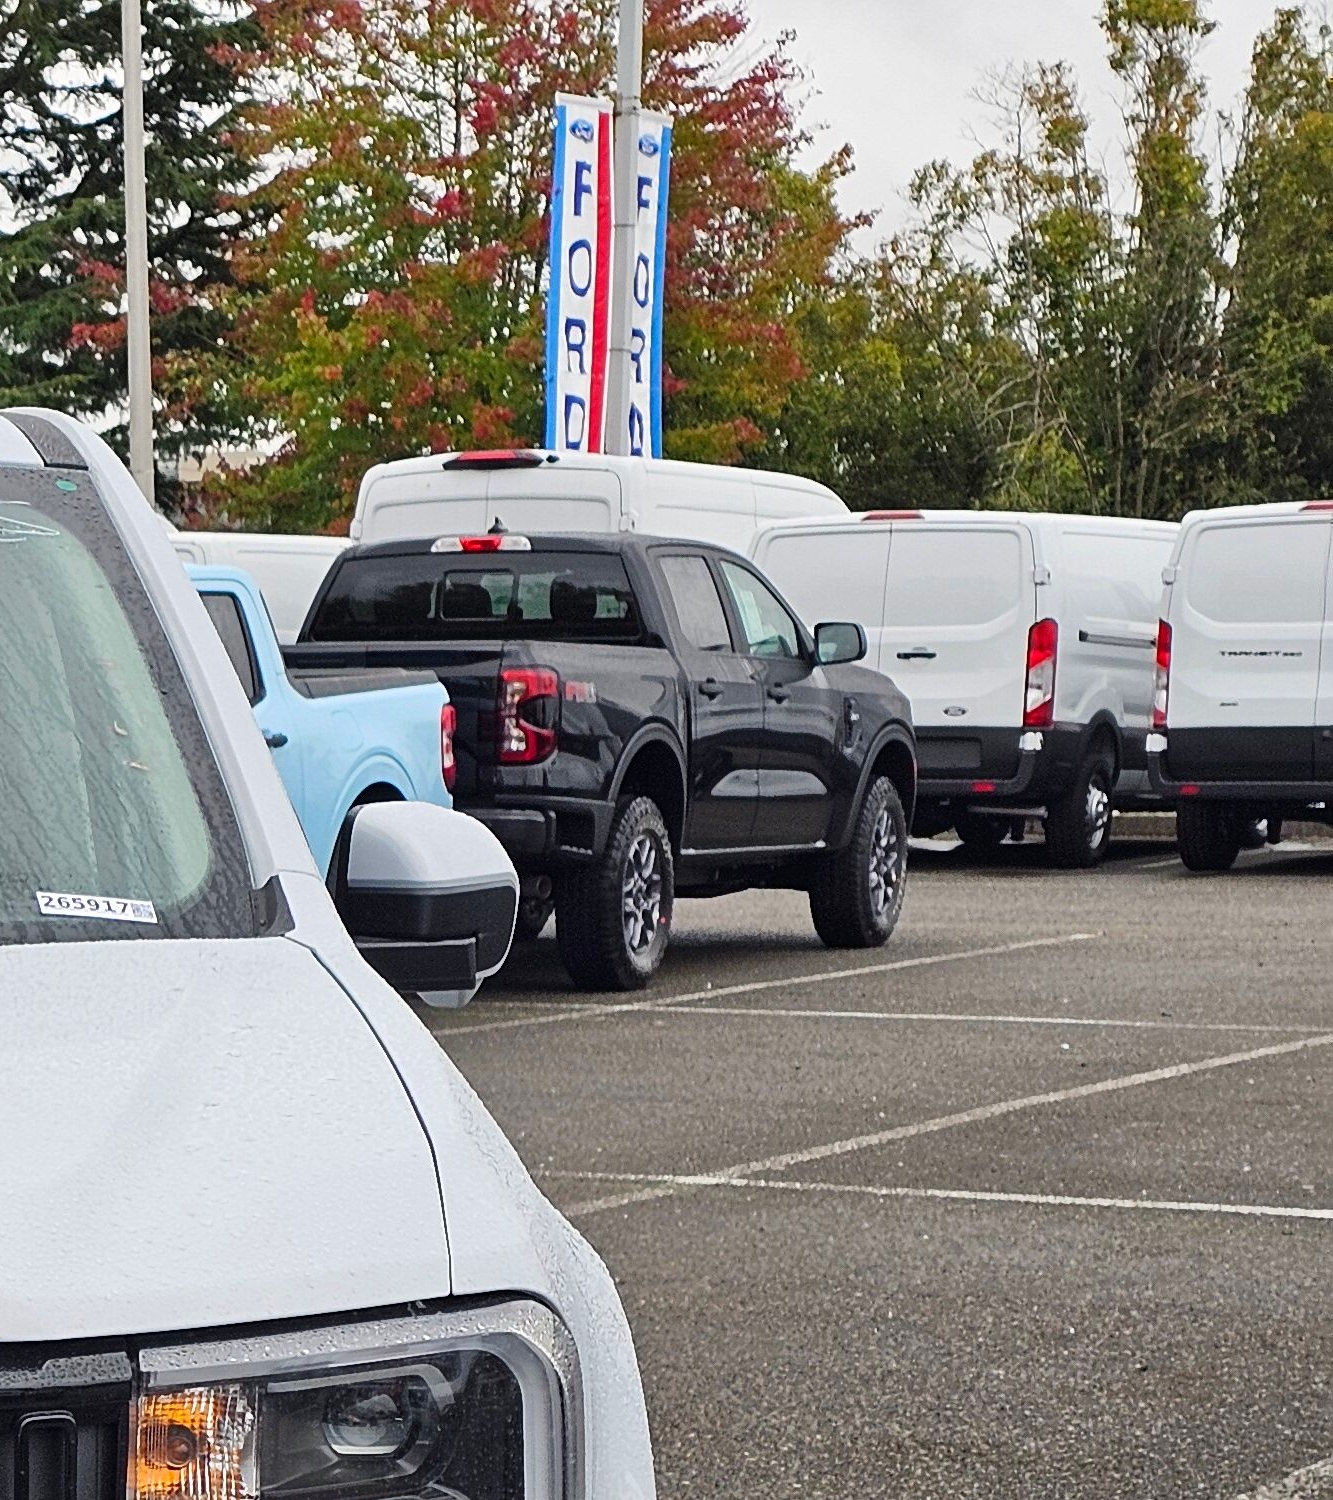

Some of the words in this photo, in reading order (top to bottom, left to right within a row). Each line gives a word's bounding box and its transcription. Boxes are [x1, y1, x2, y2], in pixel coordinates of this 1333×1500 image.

[565, 160, 592, 451] FORD
[630, 175, 653, 456] FORD
[41, 895, 129, 913] 265917
